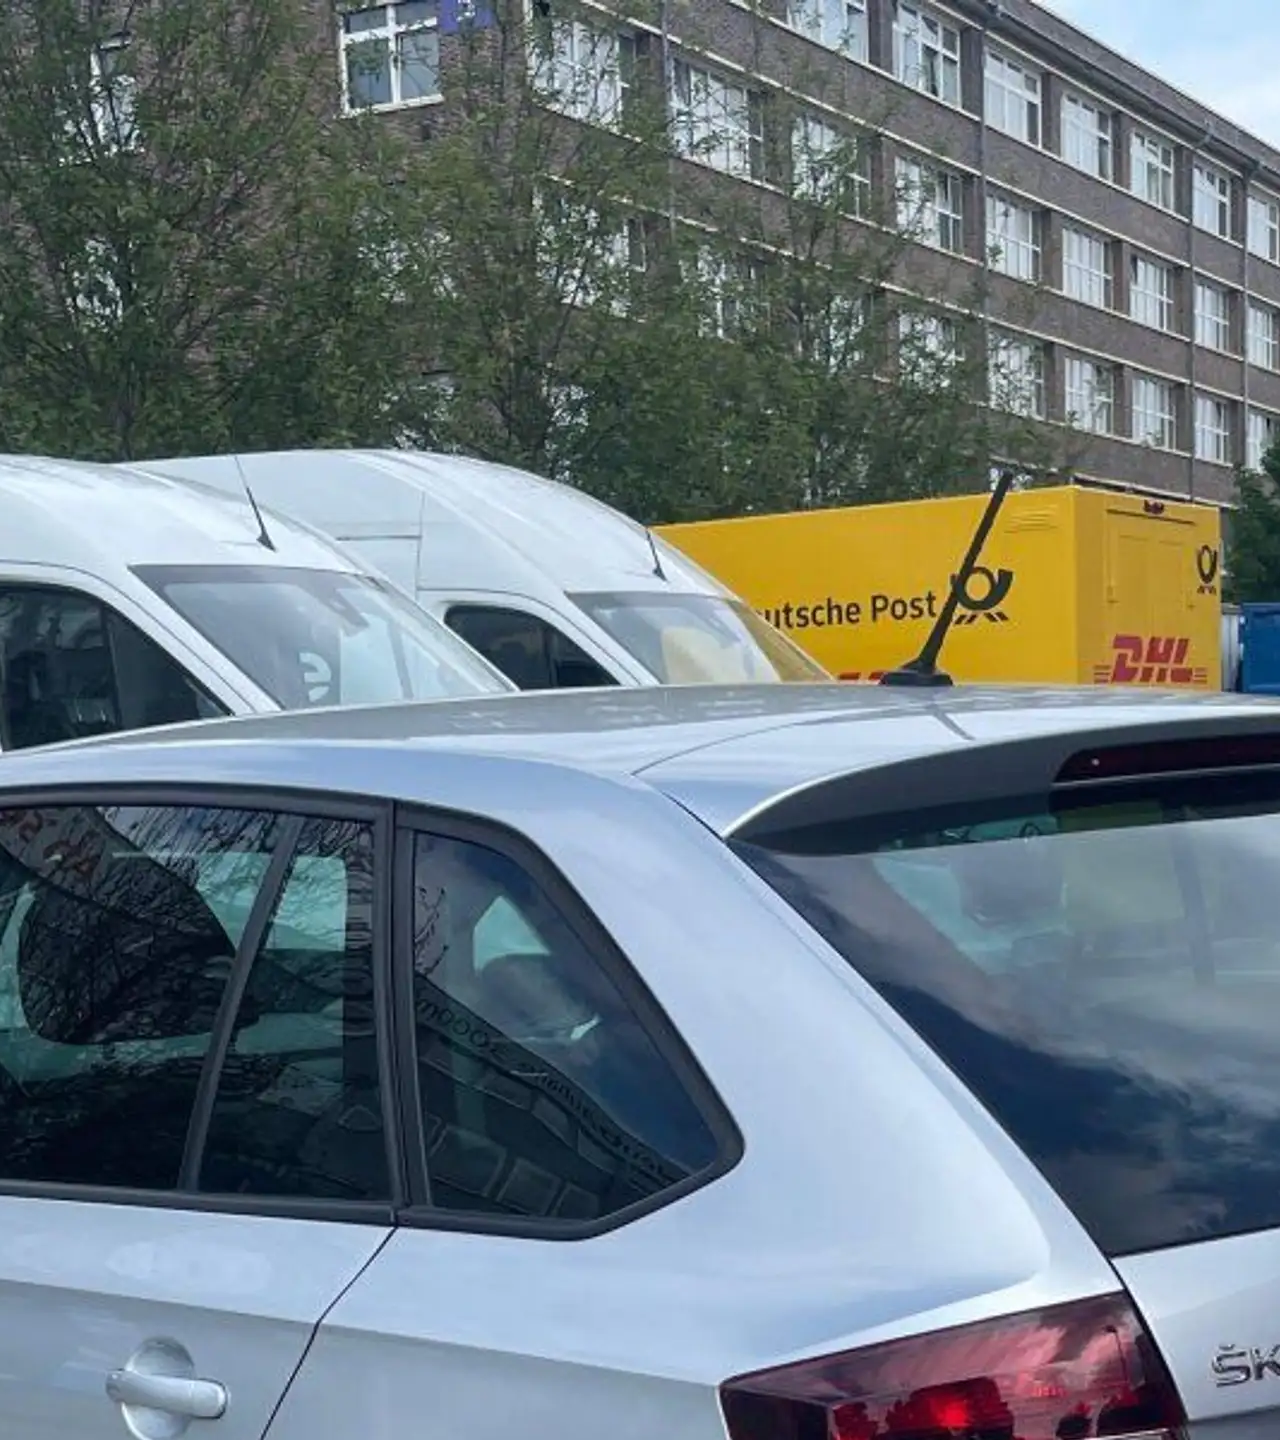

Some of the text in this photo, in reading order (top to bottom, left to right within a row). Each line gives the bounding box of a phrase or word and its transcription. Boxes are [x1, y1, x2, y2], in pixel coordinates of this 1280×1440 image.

[757, 590, 937, 629] utsche Post
[1111, 634, 1194, 683] DHL
